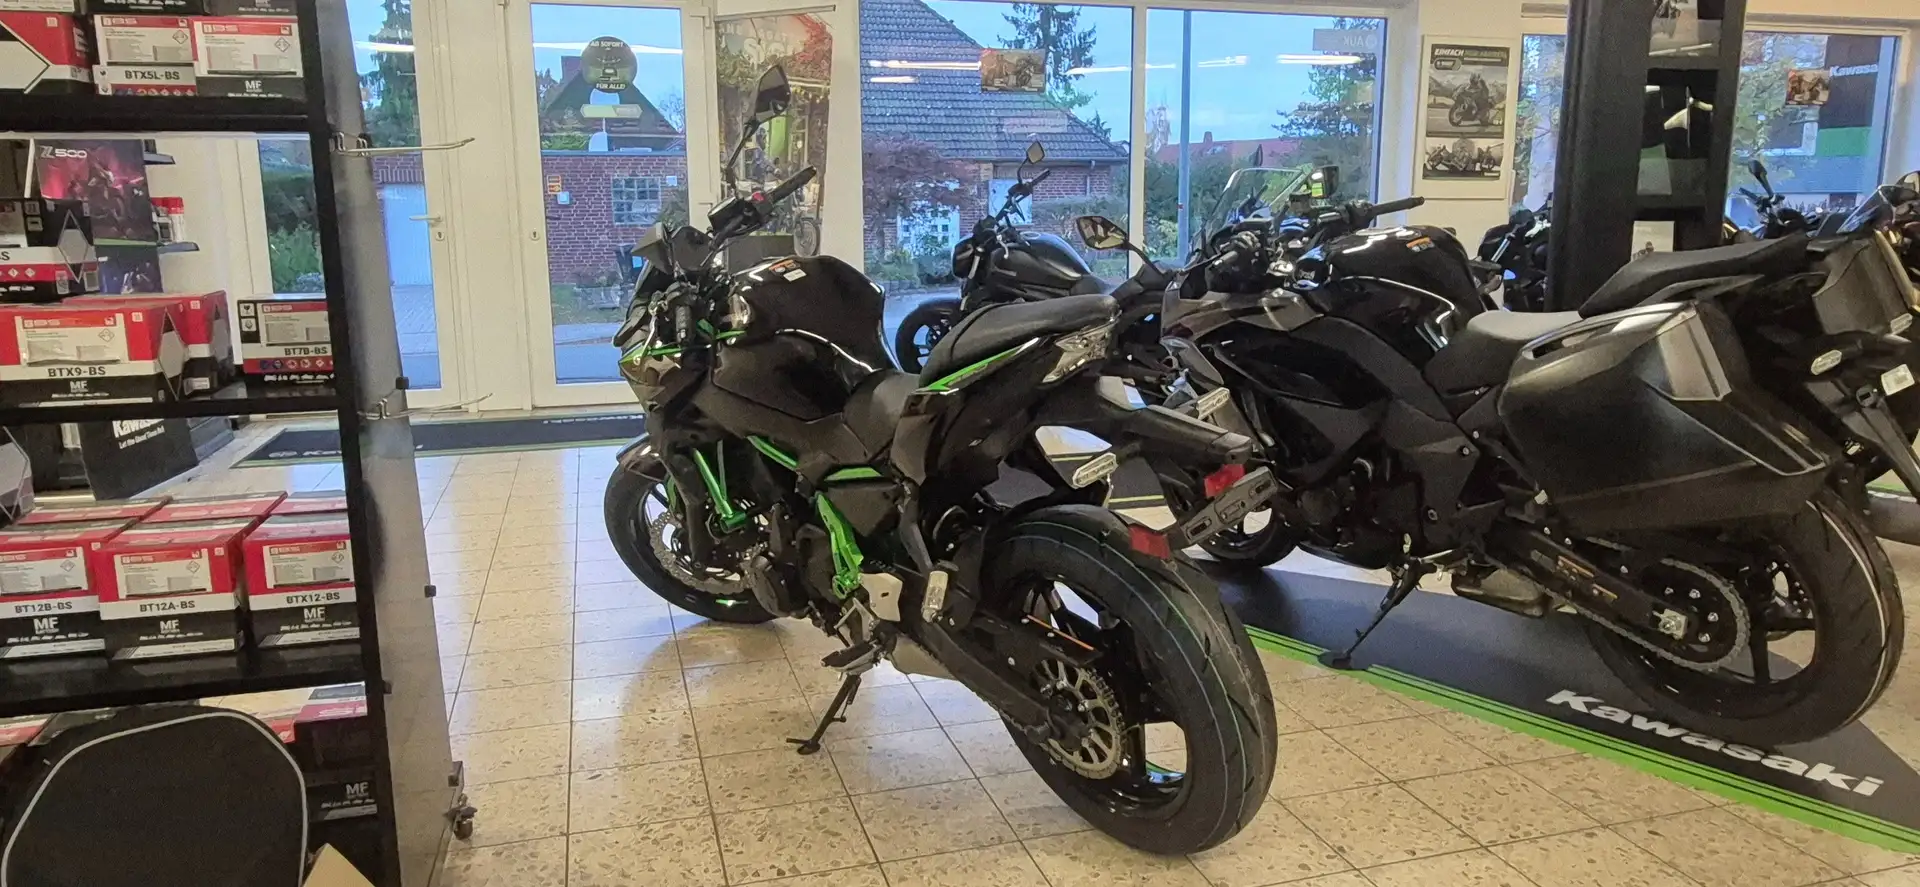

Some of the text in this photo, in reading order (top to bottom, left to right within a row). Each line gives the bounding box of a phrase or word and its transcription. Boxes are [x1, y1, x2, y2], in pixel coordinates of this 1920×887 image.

[124, 70, 181, 81] BTX5L-BS
[1829, 64, 1878, 77] Kawasa
[245, 80, 262, 89] MF
[48, 366, 106, 377] BTX9-BS
[69, 380, 88, 389] MF
[286, 592, 340, 604] BTX12-BS
[14, 601, 73, 614] BT12B-BS
[139, 601, 196, 613] BT12A-BS
[303, 607, 326, 619] MF
[33, 617, 59, 630] MF
[159, 620, 180, 630] MF
[1546, 690, 1885, 796] Kawasaki
[346, 782, 370, 795] MF
